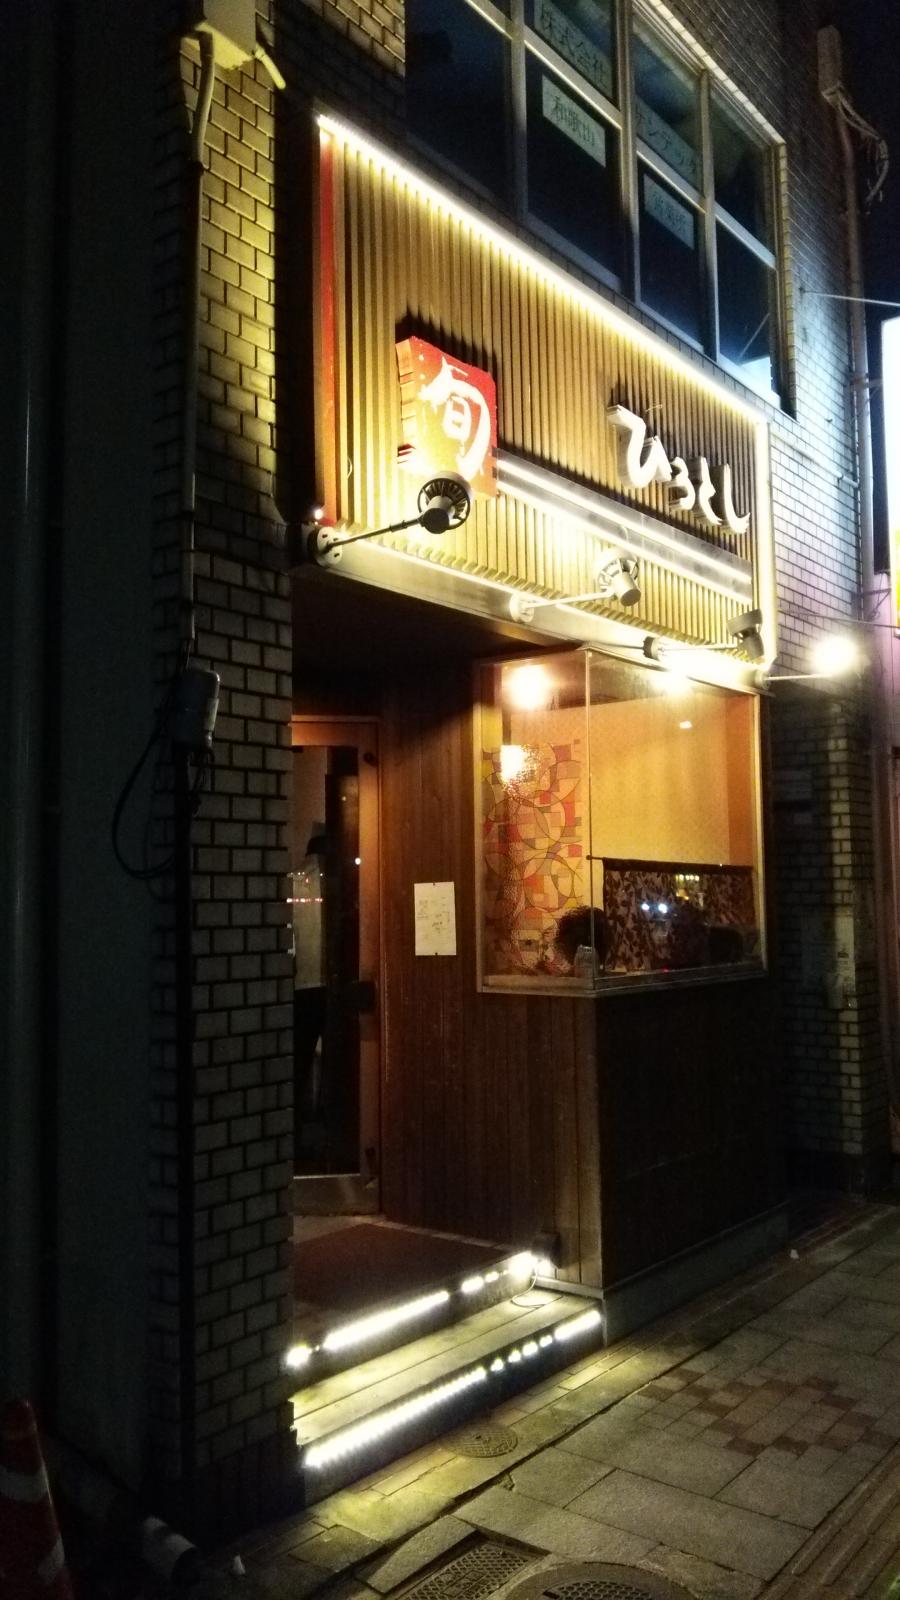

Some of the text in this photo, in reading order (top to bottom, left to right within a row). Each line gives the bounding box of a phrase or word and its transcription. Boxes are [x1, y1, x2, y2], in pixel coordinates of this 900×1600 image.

[418, 356, 491, 481] 旬
[607, 405, 750, 534] ひろとし
